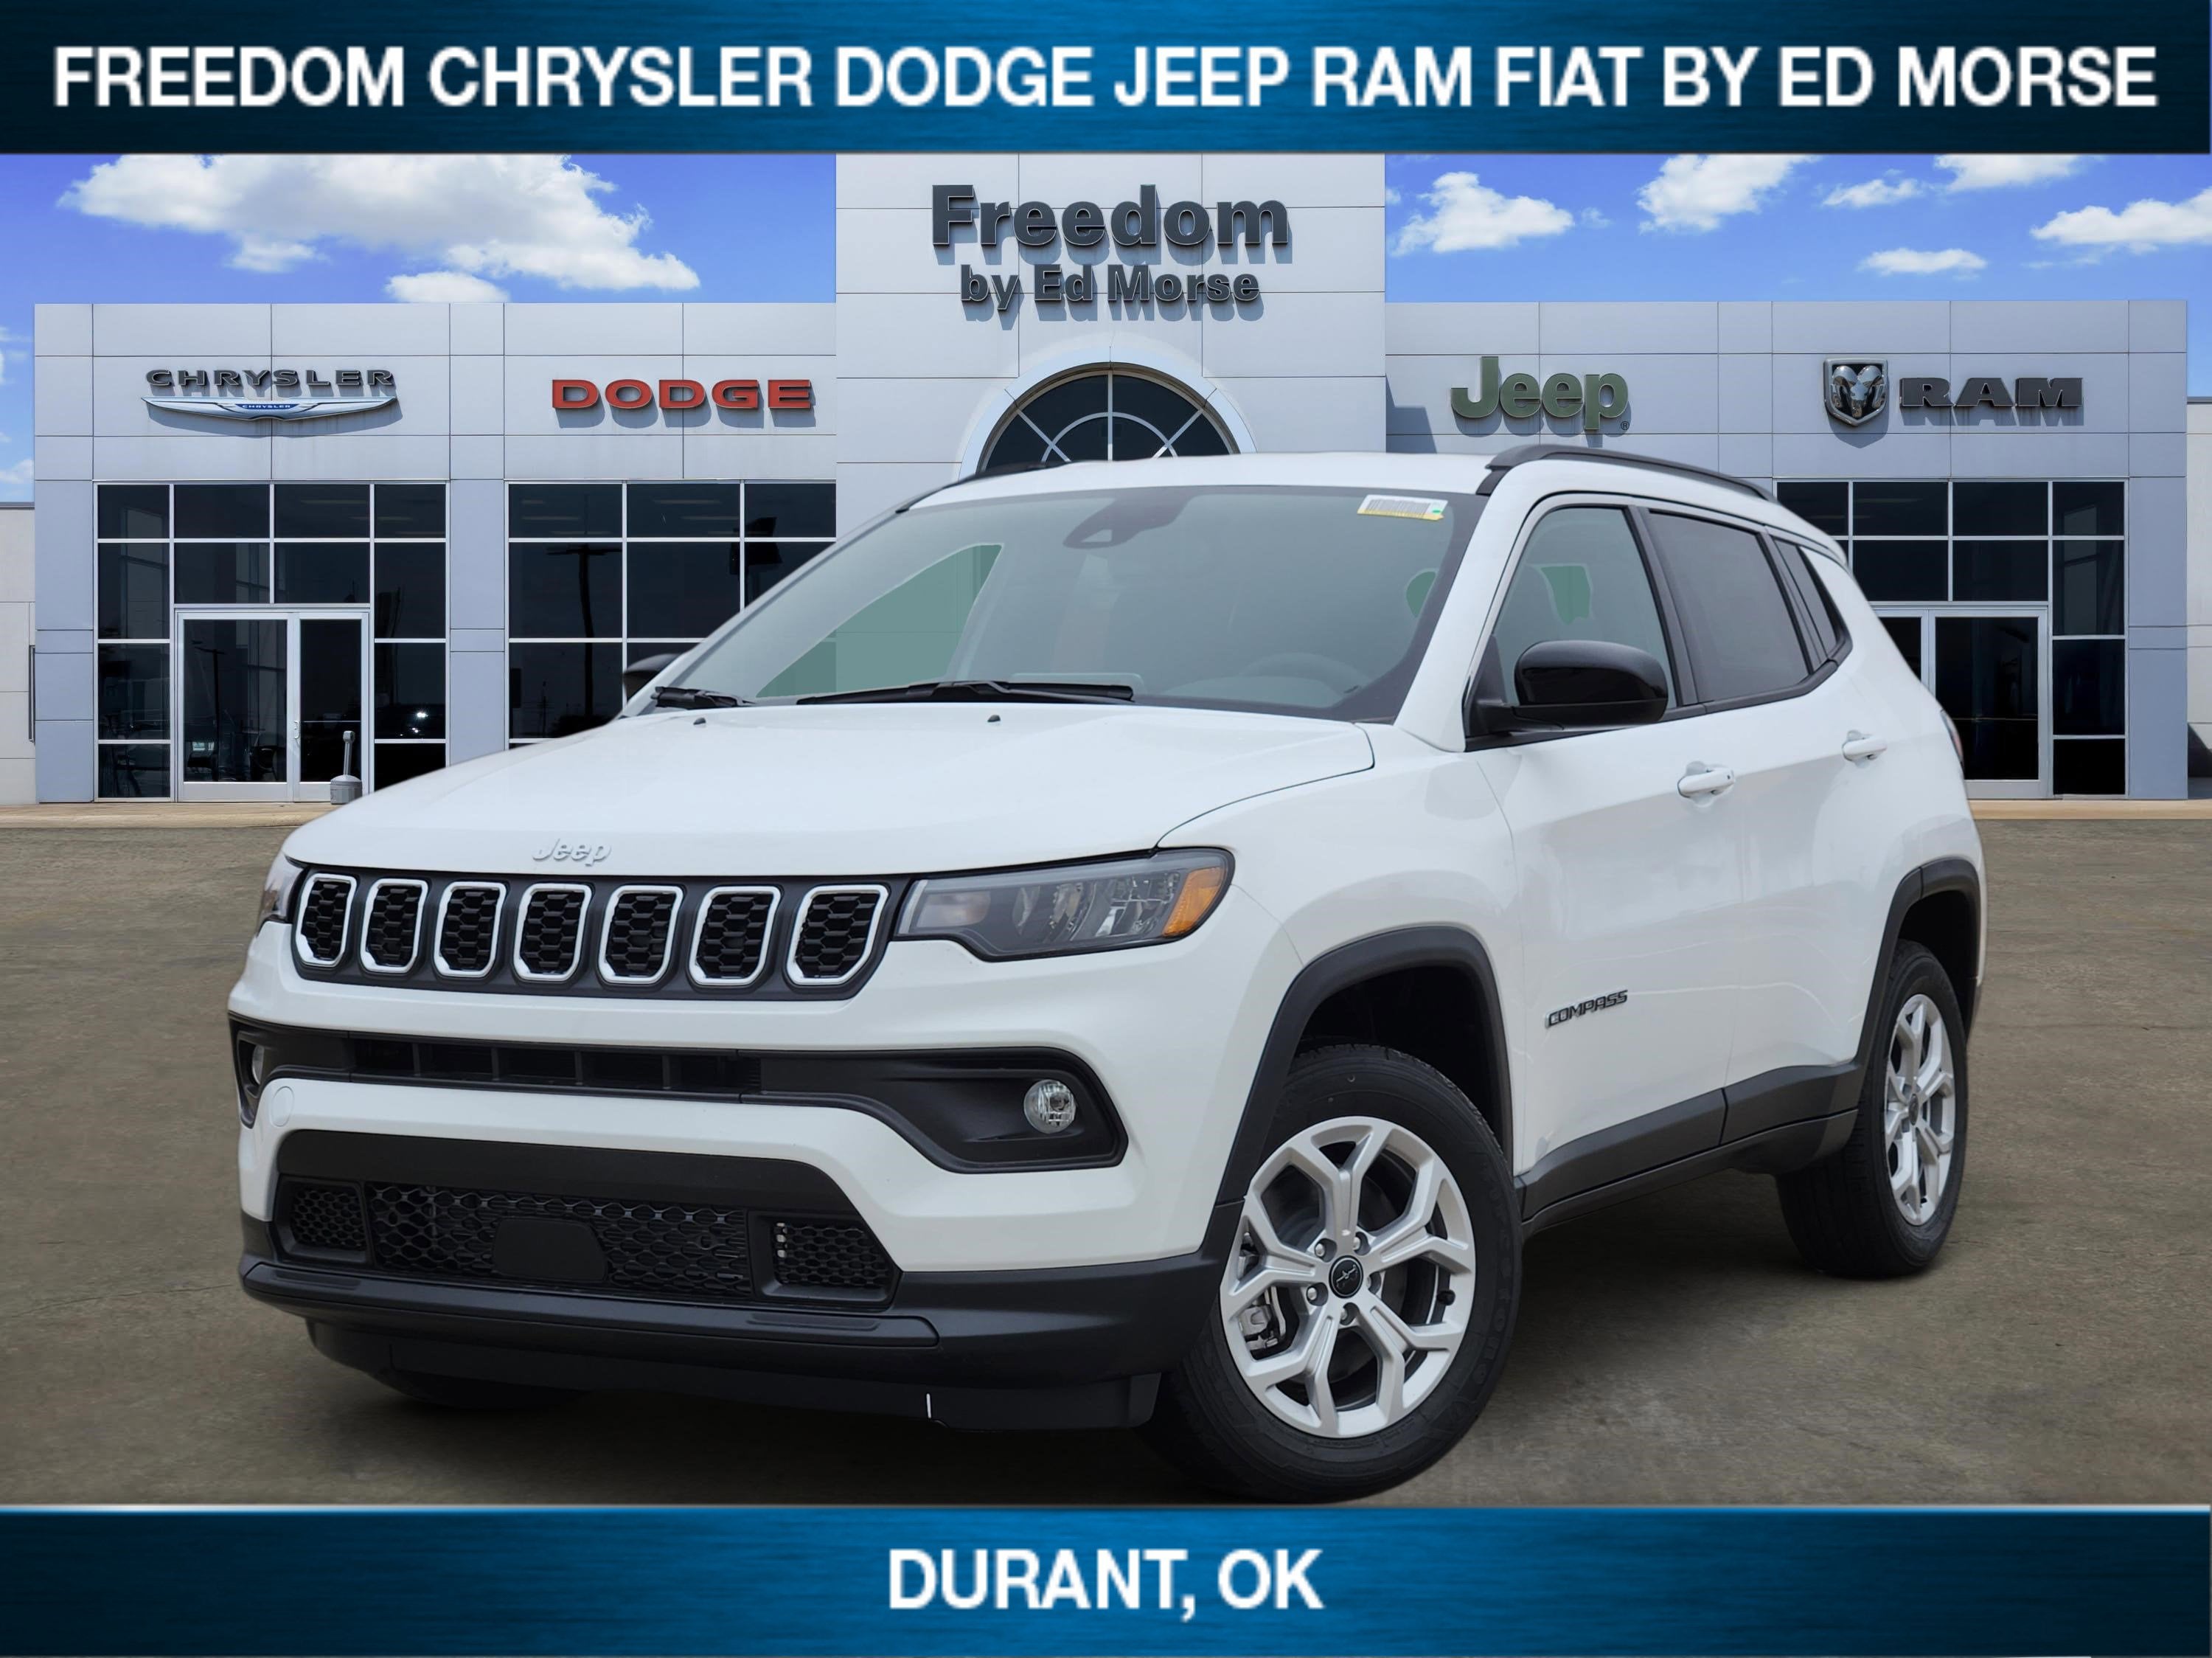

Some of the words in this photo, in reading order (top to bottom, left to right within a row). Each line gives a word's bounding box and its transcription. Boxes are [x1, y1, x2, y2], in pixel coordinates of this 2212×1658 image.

[931, 184, 1289, 247] Freedom
[960, 264, 1020, 311] by
[1034, 264, 1093, 302] Ed
[1106, 264, 1261, 302] Morse
[145, 369, 394, 387] CHRYSLER
[552, 378, 812, 409] DODGE
[1450, 355, 1629, 431] Jeep
[1899, 377, 2084, 407] RAM
[532, 839, 611, 867] Jeep
[1545, 989, 1629, 1028] COMPASS
